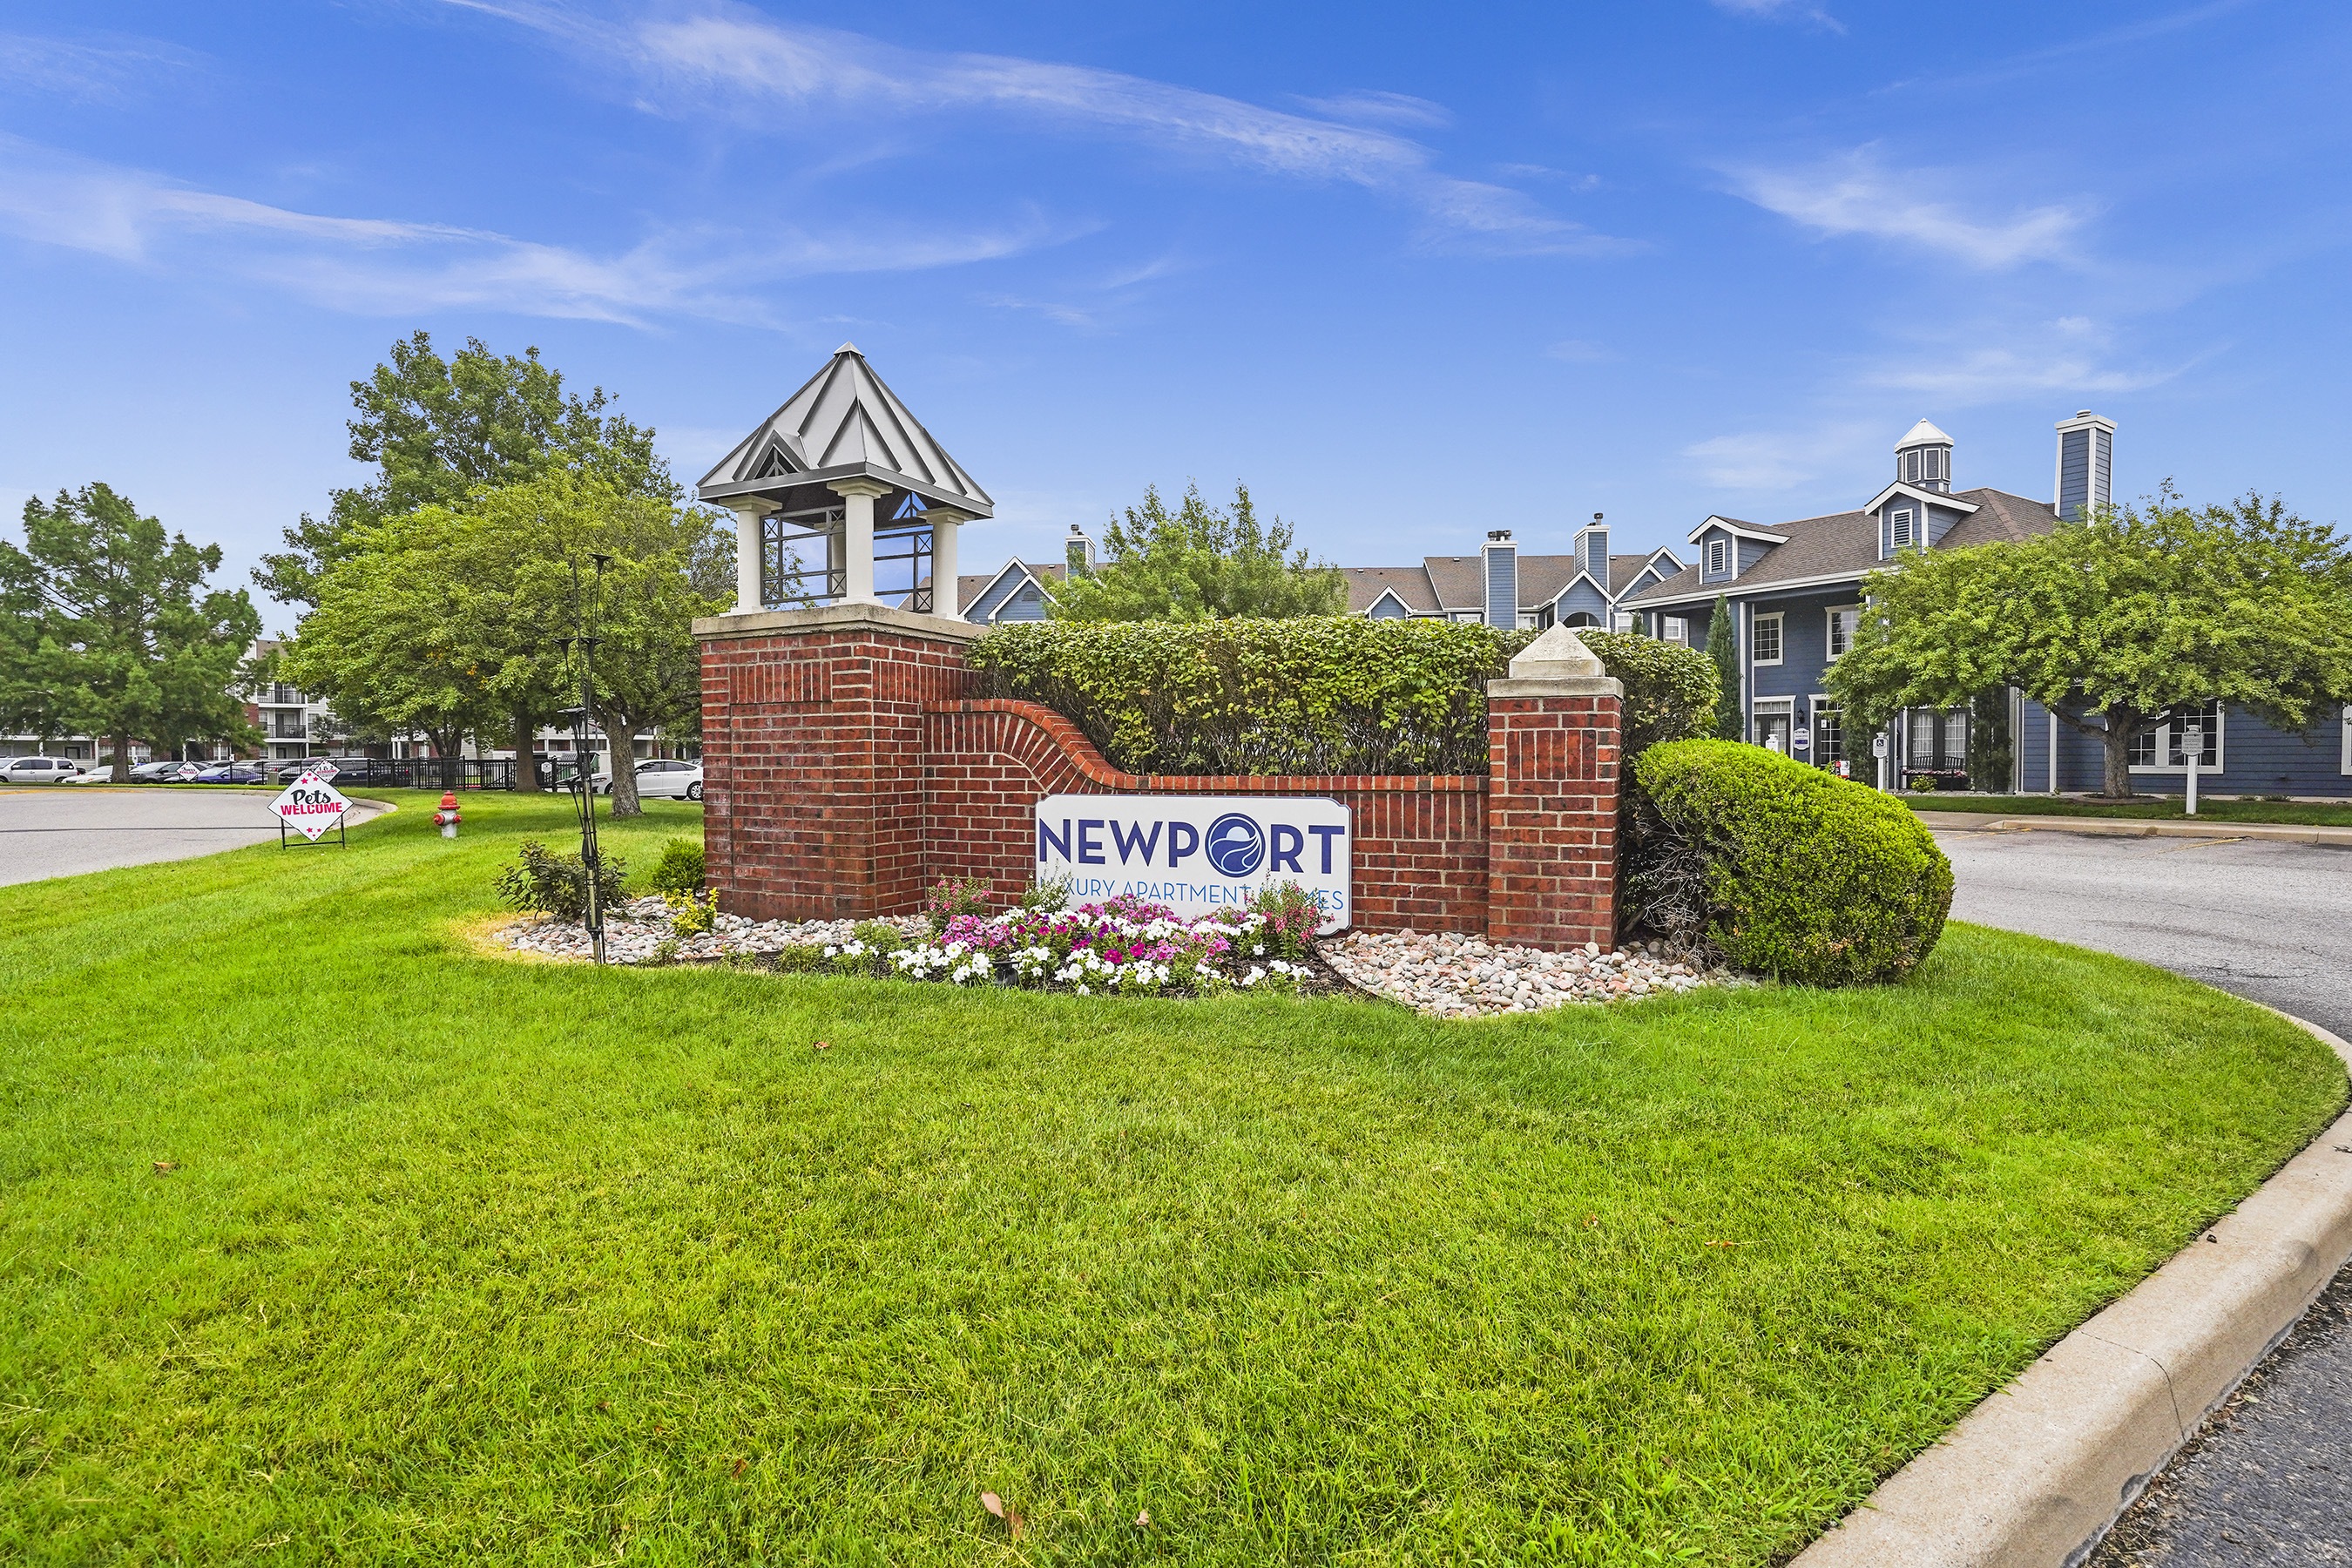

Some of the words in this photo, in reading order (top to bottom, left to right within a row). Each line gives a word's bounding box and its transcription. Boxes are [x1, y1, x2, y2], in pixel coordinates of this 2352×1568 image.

[290, 788, 332, 805] Pets
[280, 801, 343, 816] WELCOME
[1038, 812, 1346, 879] NEWPORT
